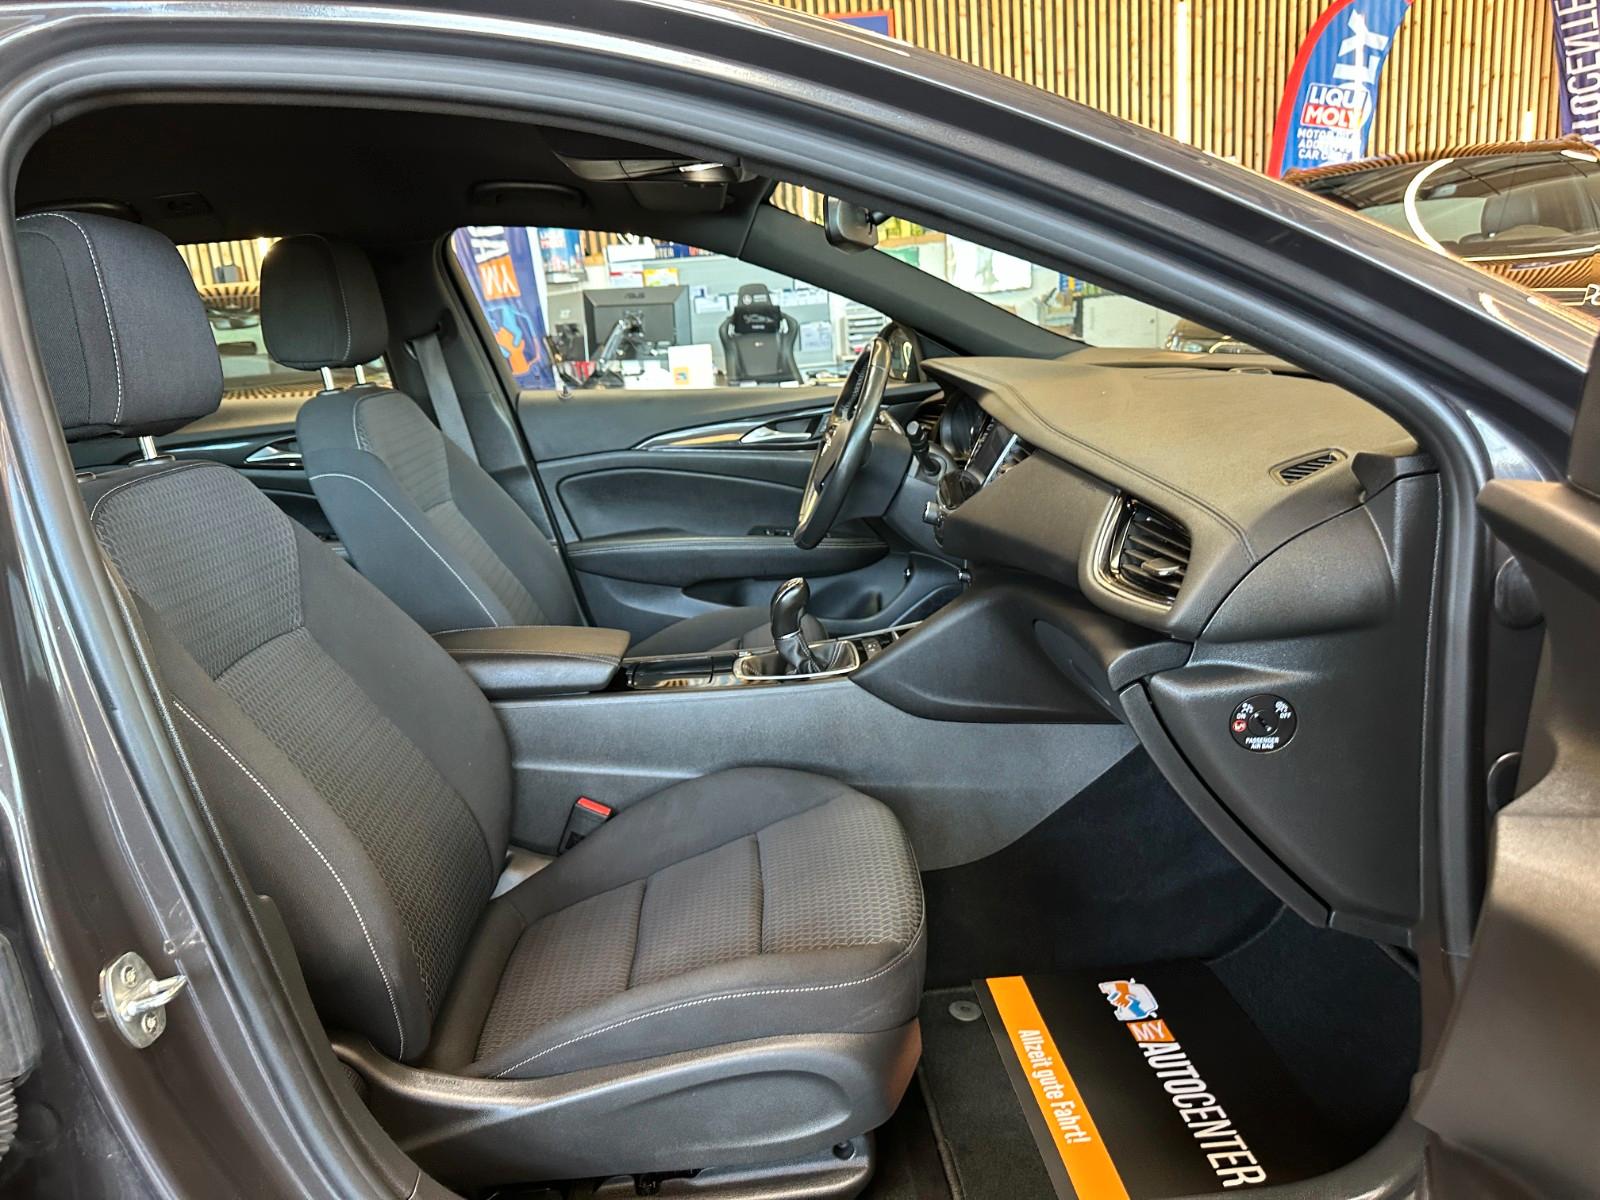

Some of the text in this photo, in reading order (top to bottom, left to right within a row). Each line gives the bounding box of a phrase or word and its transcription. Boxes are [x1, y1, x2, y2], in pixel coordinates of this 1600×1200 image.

[1304, 105, 1360, 129] MOLY
[1245, 737, 1280, 745] PASSENGER
[1128, 1022, 1166, 1042] MY
[1018, 1030, 1091, 1144] Allzeit gute Fahrt!
[1138, 1042, 1267, 1188] AUTOCENTER
